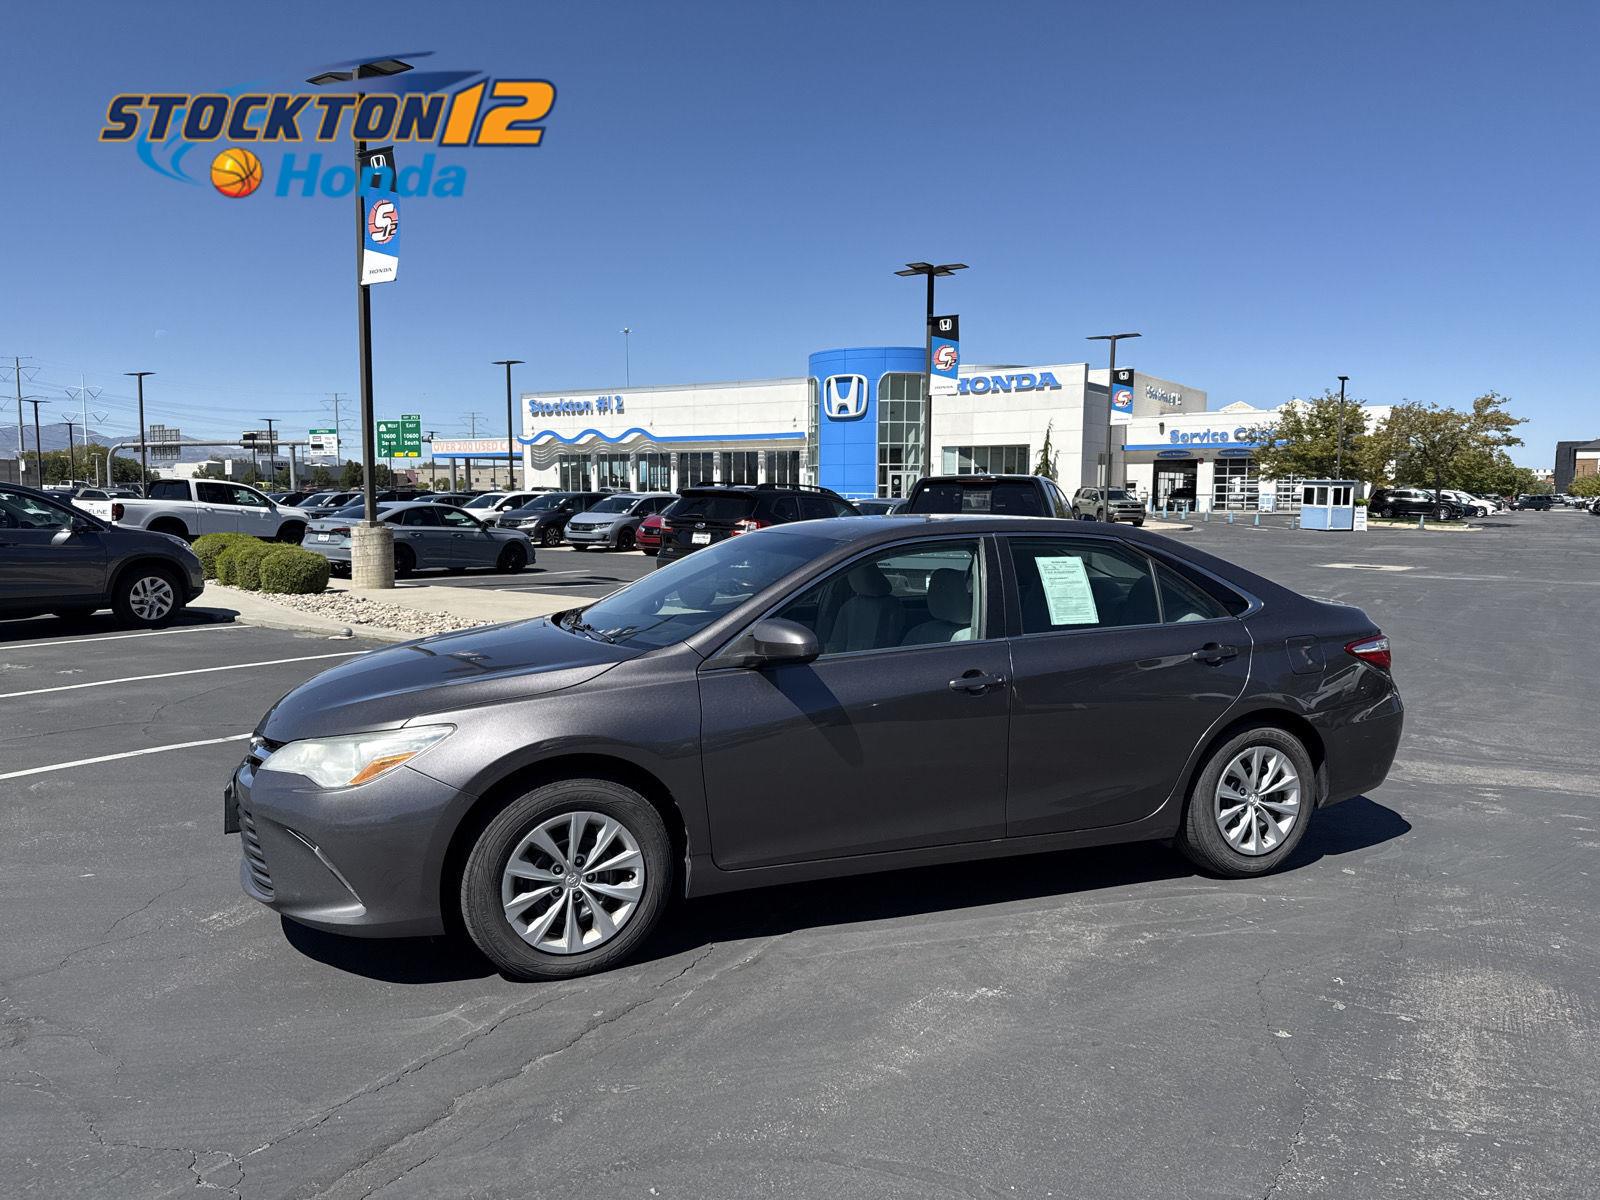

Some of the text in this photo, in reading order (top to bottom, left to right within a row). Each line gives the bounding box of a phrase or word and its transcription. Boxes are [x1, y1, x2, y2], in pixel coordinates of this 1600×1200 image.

[369, 267, 393, 275] HONDA
[528, 395, 625, 415] Stockton #12
[1170, 428, 1229, 444] Service
[433, 441, 456, 452] OVER
[458, 441, 473, 452] 200
[474, 440, 498, 452] USED
